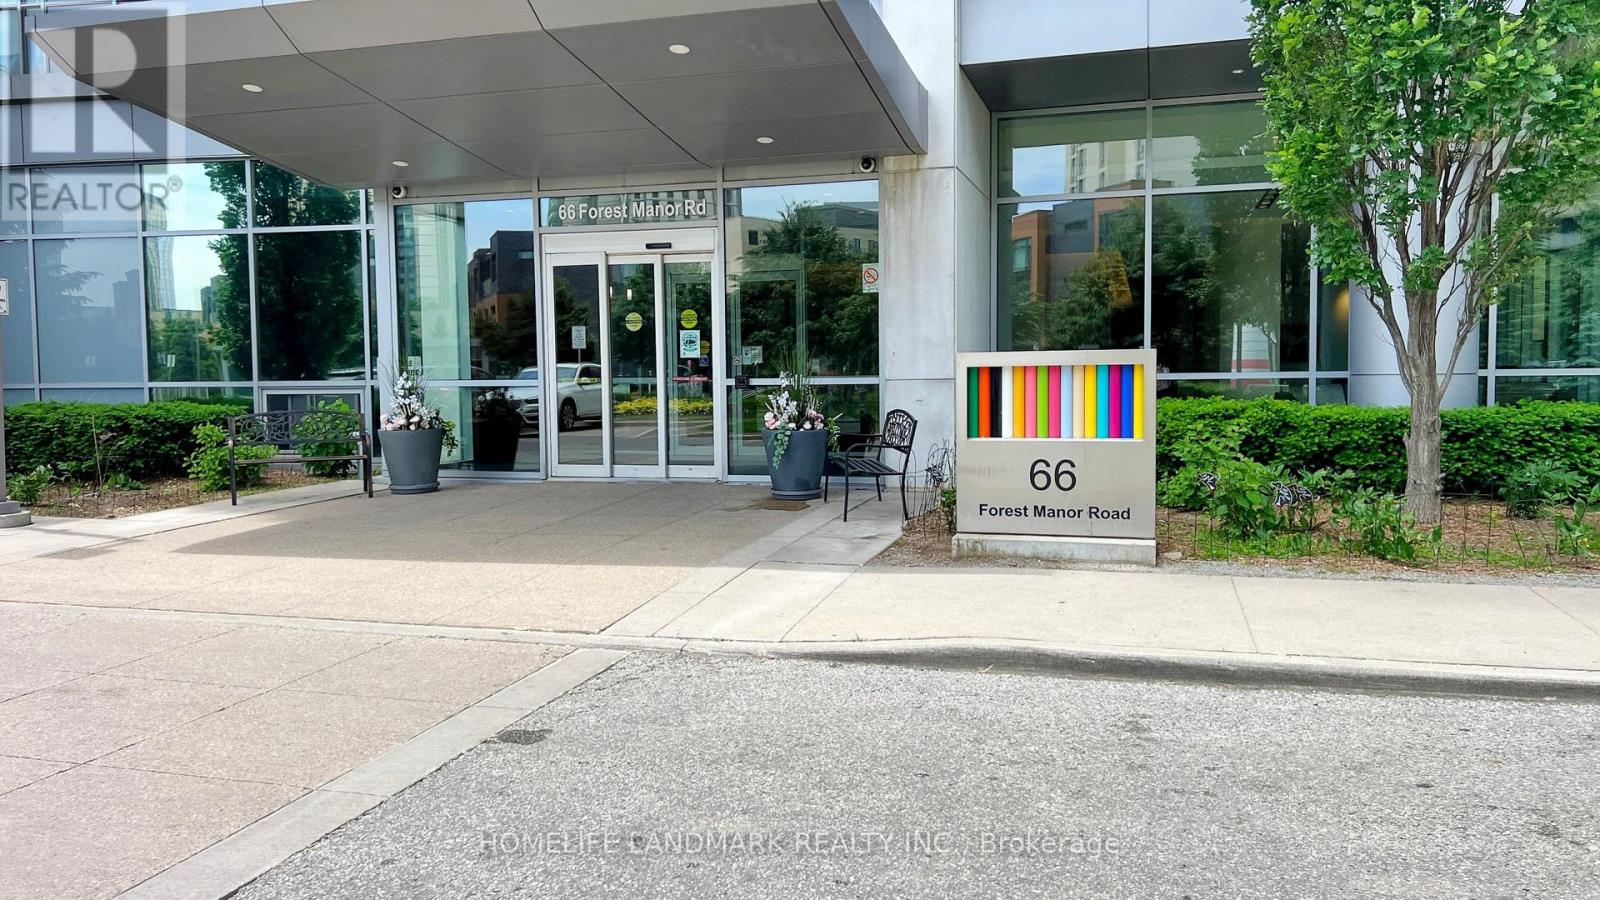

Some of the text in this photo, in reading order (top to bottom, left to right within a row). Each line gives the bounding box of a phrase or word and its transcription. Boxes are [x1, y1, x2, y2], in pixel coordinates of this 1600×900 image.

[558, 199, 706, 220] 66 Forest Manor Rd
[1029, 458, 1077, 491] 66
[979, 503, 1131, 520] Forest Manor Road
